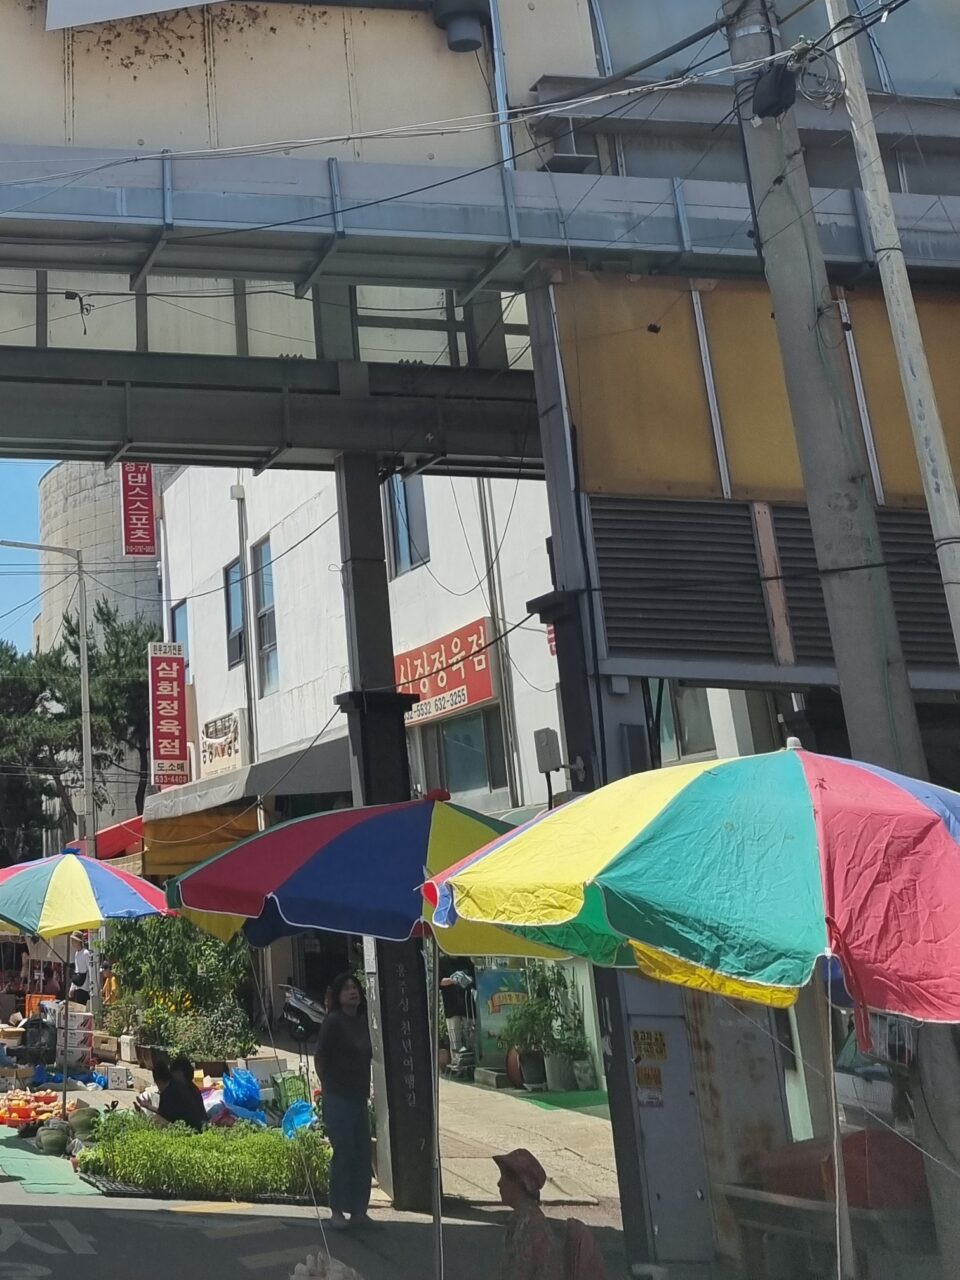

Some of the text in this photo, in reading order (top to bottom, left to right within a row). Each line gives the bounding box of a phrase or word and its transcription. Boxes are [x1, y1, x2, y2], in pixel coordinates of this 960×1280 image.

[128, 473, 151, 543] 댄스스포츠
[398, 625, 486, 694] 시장정육점
[156, 662, 182, 756] 삼화정육점
[434, 688, 466, 712] 632-3255
